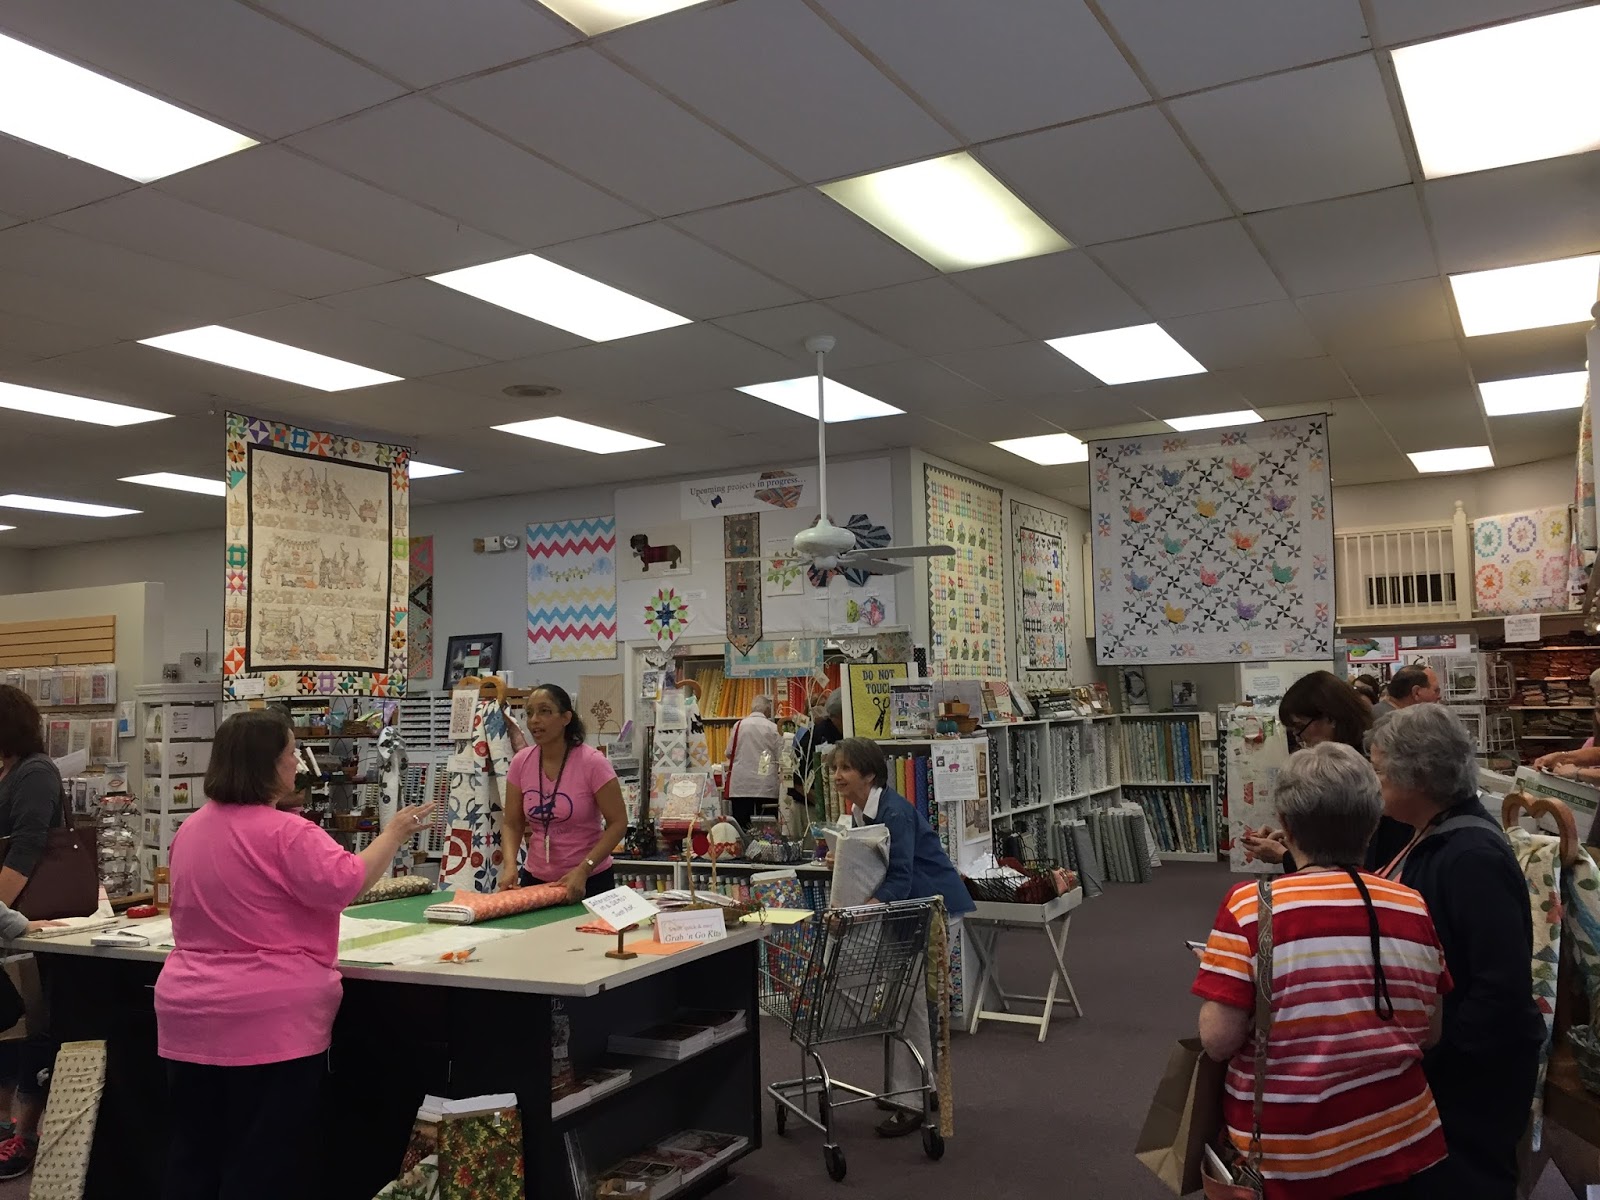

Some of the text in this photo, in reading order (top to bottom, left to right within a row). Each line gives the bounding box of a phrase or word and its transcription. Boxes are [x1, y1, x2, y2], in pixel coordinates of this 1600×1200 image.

[690, 486, 725, 497] Upcoming
[727, 481, 755, 493] projects
[757, 479, 765, 488] in
[862, 669, 895, 681] DO NOT
[1541, 787, 1589, 807] STORAGE BOX
[665, 934, 684, 942] Grab
[694, 931, 706, 939] Go
[707, 930, 722, 938] Kits
